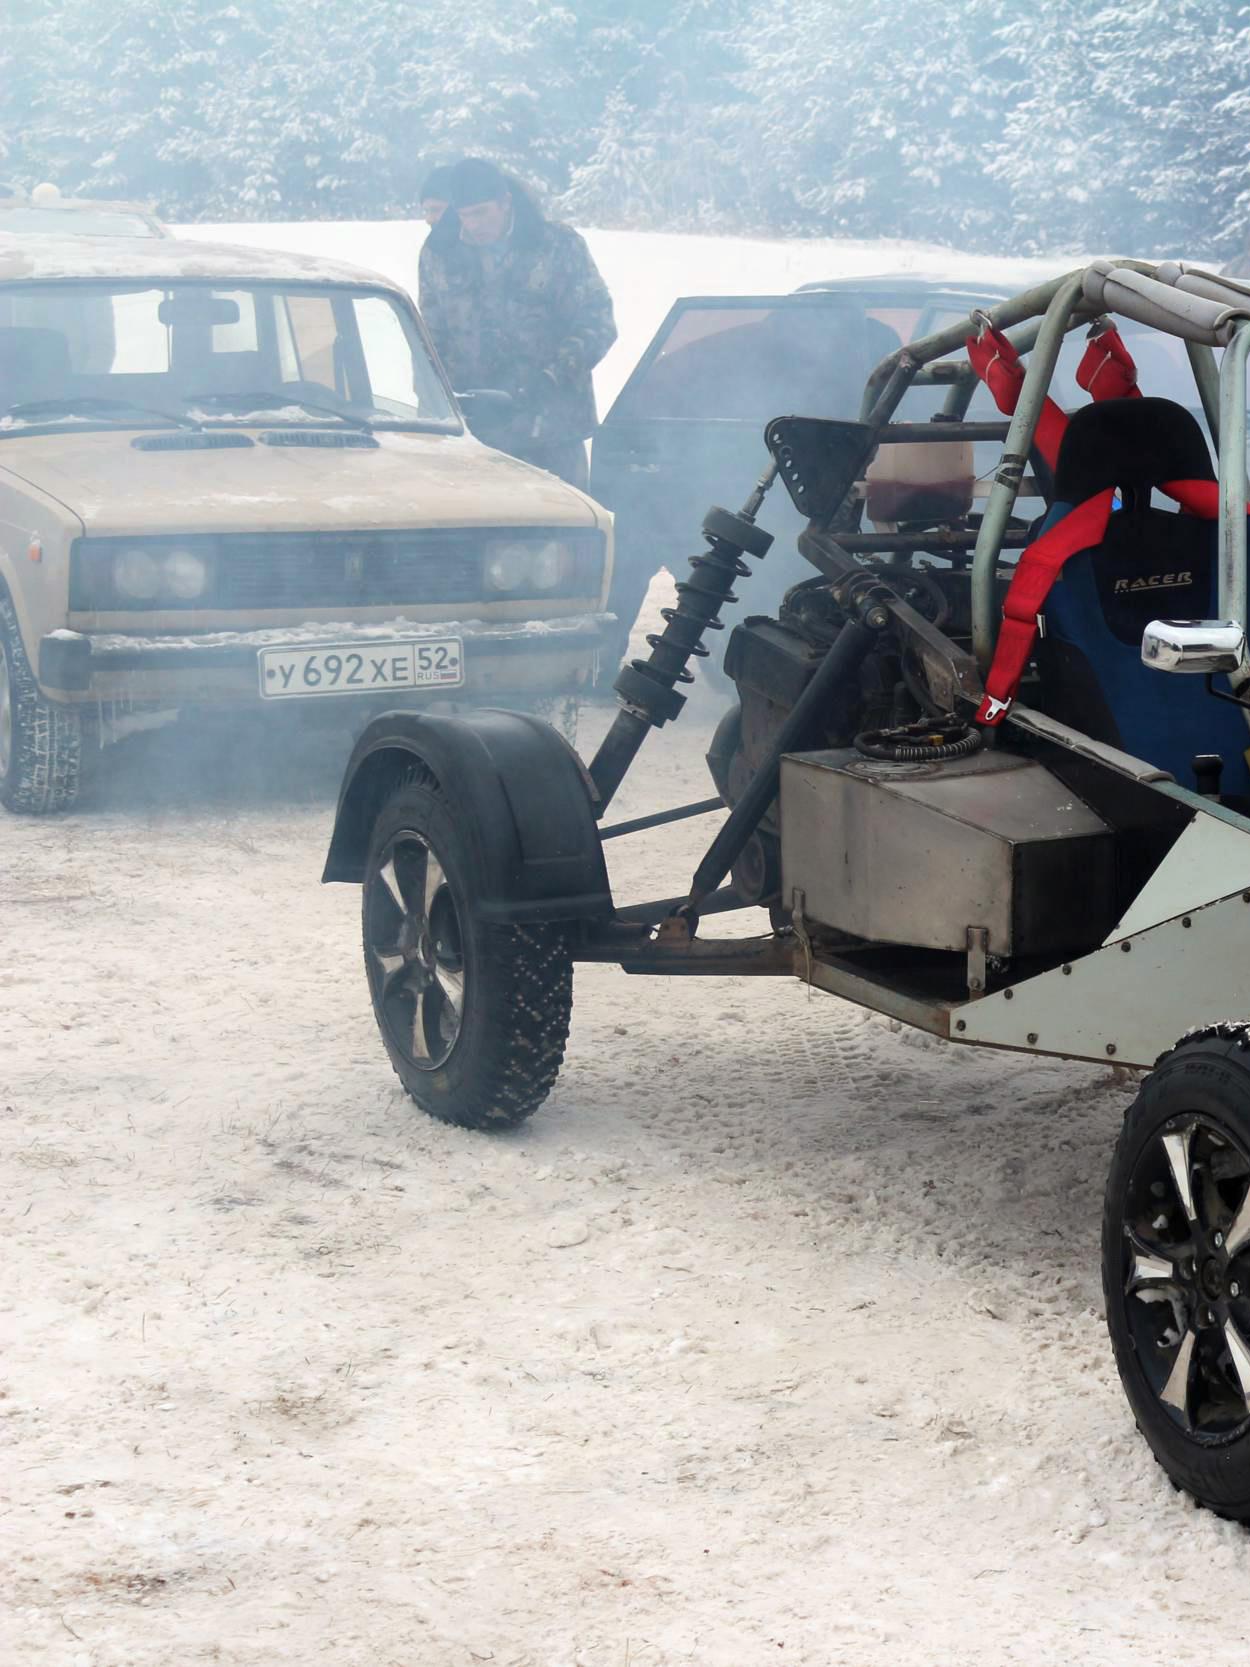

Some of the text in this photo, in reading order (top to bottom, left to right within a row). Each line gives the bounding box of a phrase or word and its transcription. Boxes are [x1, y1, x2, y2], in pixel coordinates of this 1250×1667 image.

[1114, 571, 1193, 592] RACER
[418, 646, 449, 670] 52
[417, 671, 440, 681] RUS
